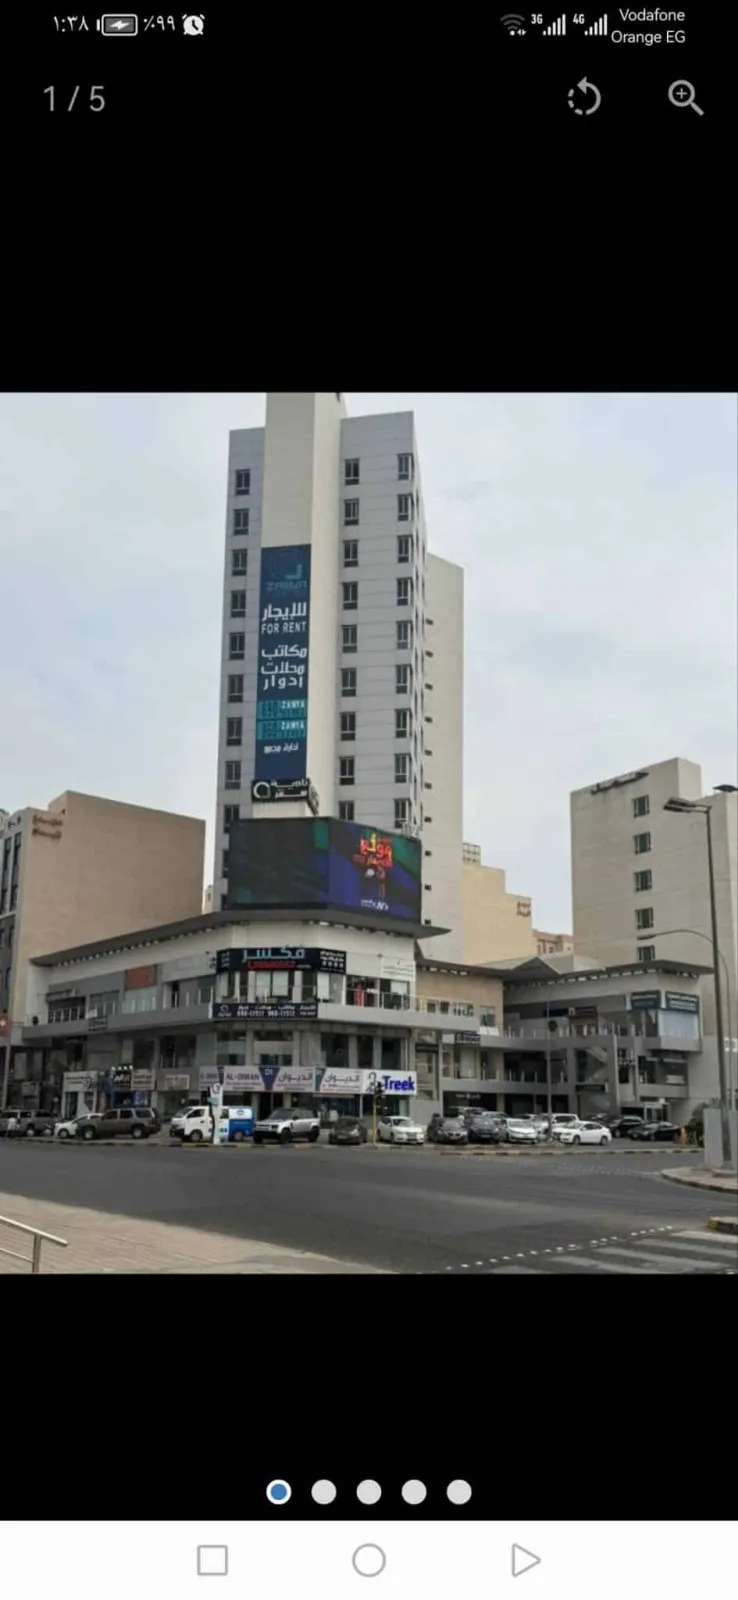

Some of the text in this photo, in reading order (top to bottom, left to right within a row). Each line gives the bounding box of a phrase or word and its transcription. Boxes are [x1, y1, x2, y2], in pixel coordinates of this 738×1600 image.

[261, 621, 307, 635] FOR RENT
[261, 644, 307, 660] مكاتب
[261, 661, 305, 675] محلات
[382, 1074, 415, 1091] Treek
